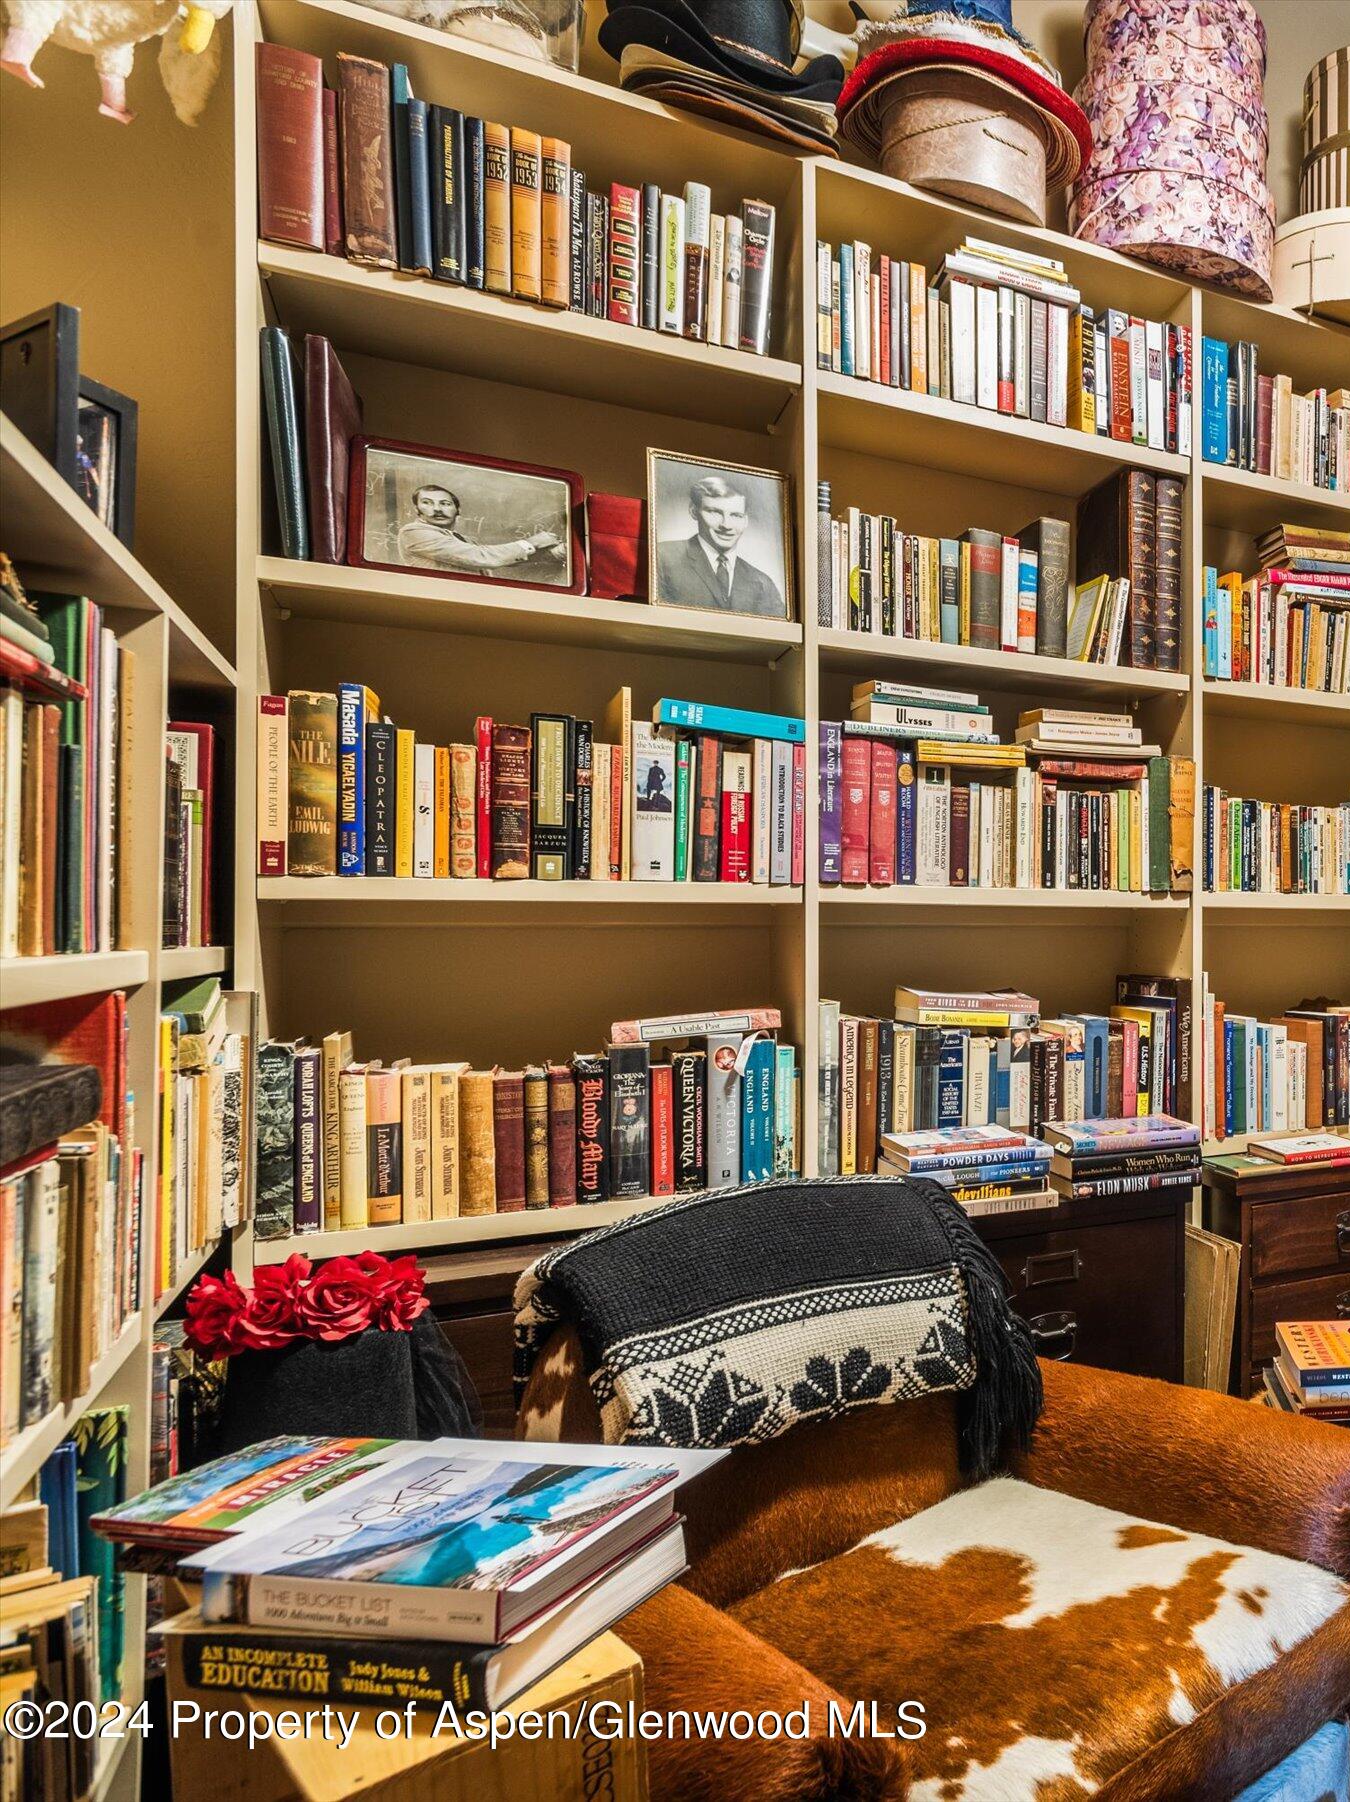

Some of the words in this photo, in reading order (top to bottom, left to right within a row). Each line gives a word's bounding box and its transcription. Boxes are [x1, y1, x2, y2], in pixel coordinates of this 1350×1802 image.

[487, 162, 508, 180] 1952
[515, 168, 538, 188] 1953
[545, 177, 567, 193] 1954
[1118, 351, 1128, 418] EINSTEIN
[342, 690, 359, 745] Masada
[300, 731, 322, 740] THE
[292, 745, 331, 765] NILE
[376, 741, 385, 843] CLEOPATRA
[296, 807, 324, 821] EMIL
[682, 1057, 694, 1102] QUEEN
[681, 1104, 694, 1168] VICTORIA
[943, 1154, 982, 1168] POWDER
[984, 1152, 1009, 1163] DAYS
[1125, 1157, 1152, 1168] Women
[1155, 1155, 1170, 1164] Who
[1172, 1154, 1191, 1163] Run
[1097, 1177, 1120, 1196] ELON
[1122, 1175, 1150, 1193] MUSK
[229, 1450, 348, 1506] MIRACLE
[263, 1590, 290, 1604] THE
[295, 1591, 354, 1609] BUCKET
[361, 1596, 392, 1611] LIST
[202, 1646, 223, 1661] AN
[227, 1647, 328, 1668] INCOMPLETE
[202, 1663, 330, 1693] EDUCATION
[350, 1661, 378, 1677] Judy
[380, 1664, 416, 1681] Jones
[418, 1667, 430, 1682] &
[342, 1677, 393, 1696] William
[396, 1683, 443, 1700] Wilson
